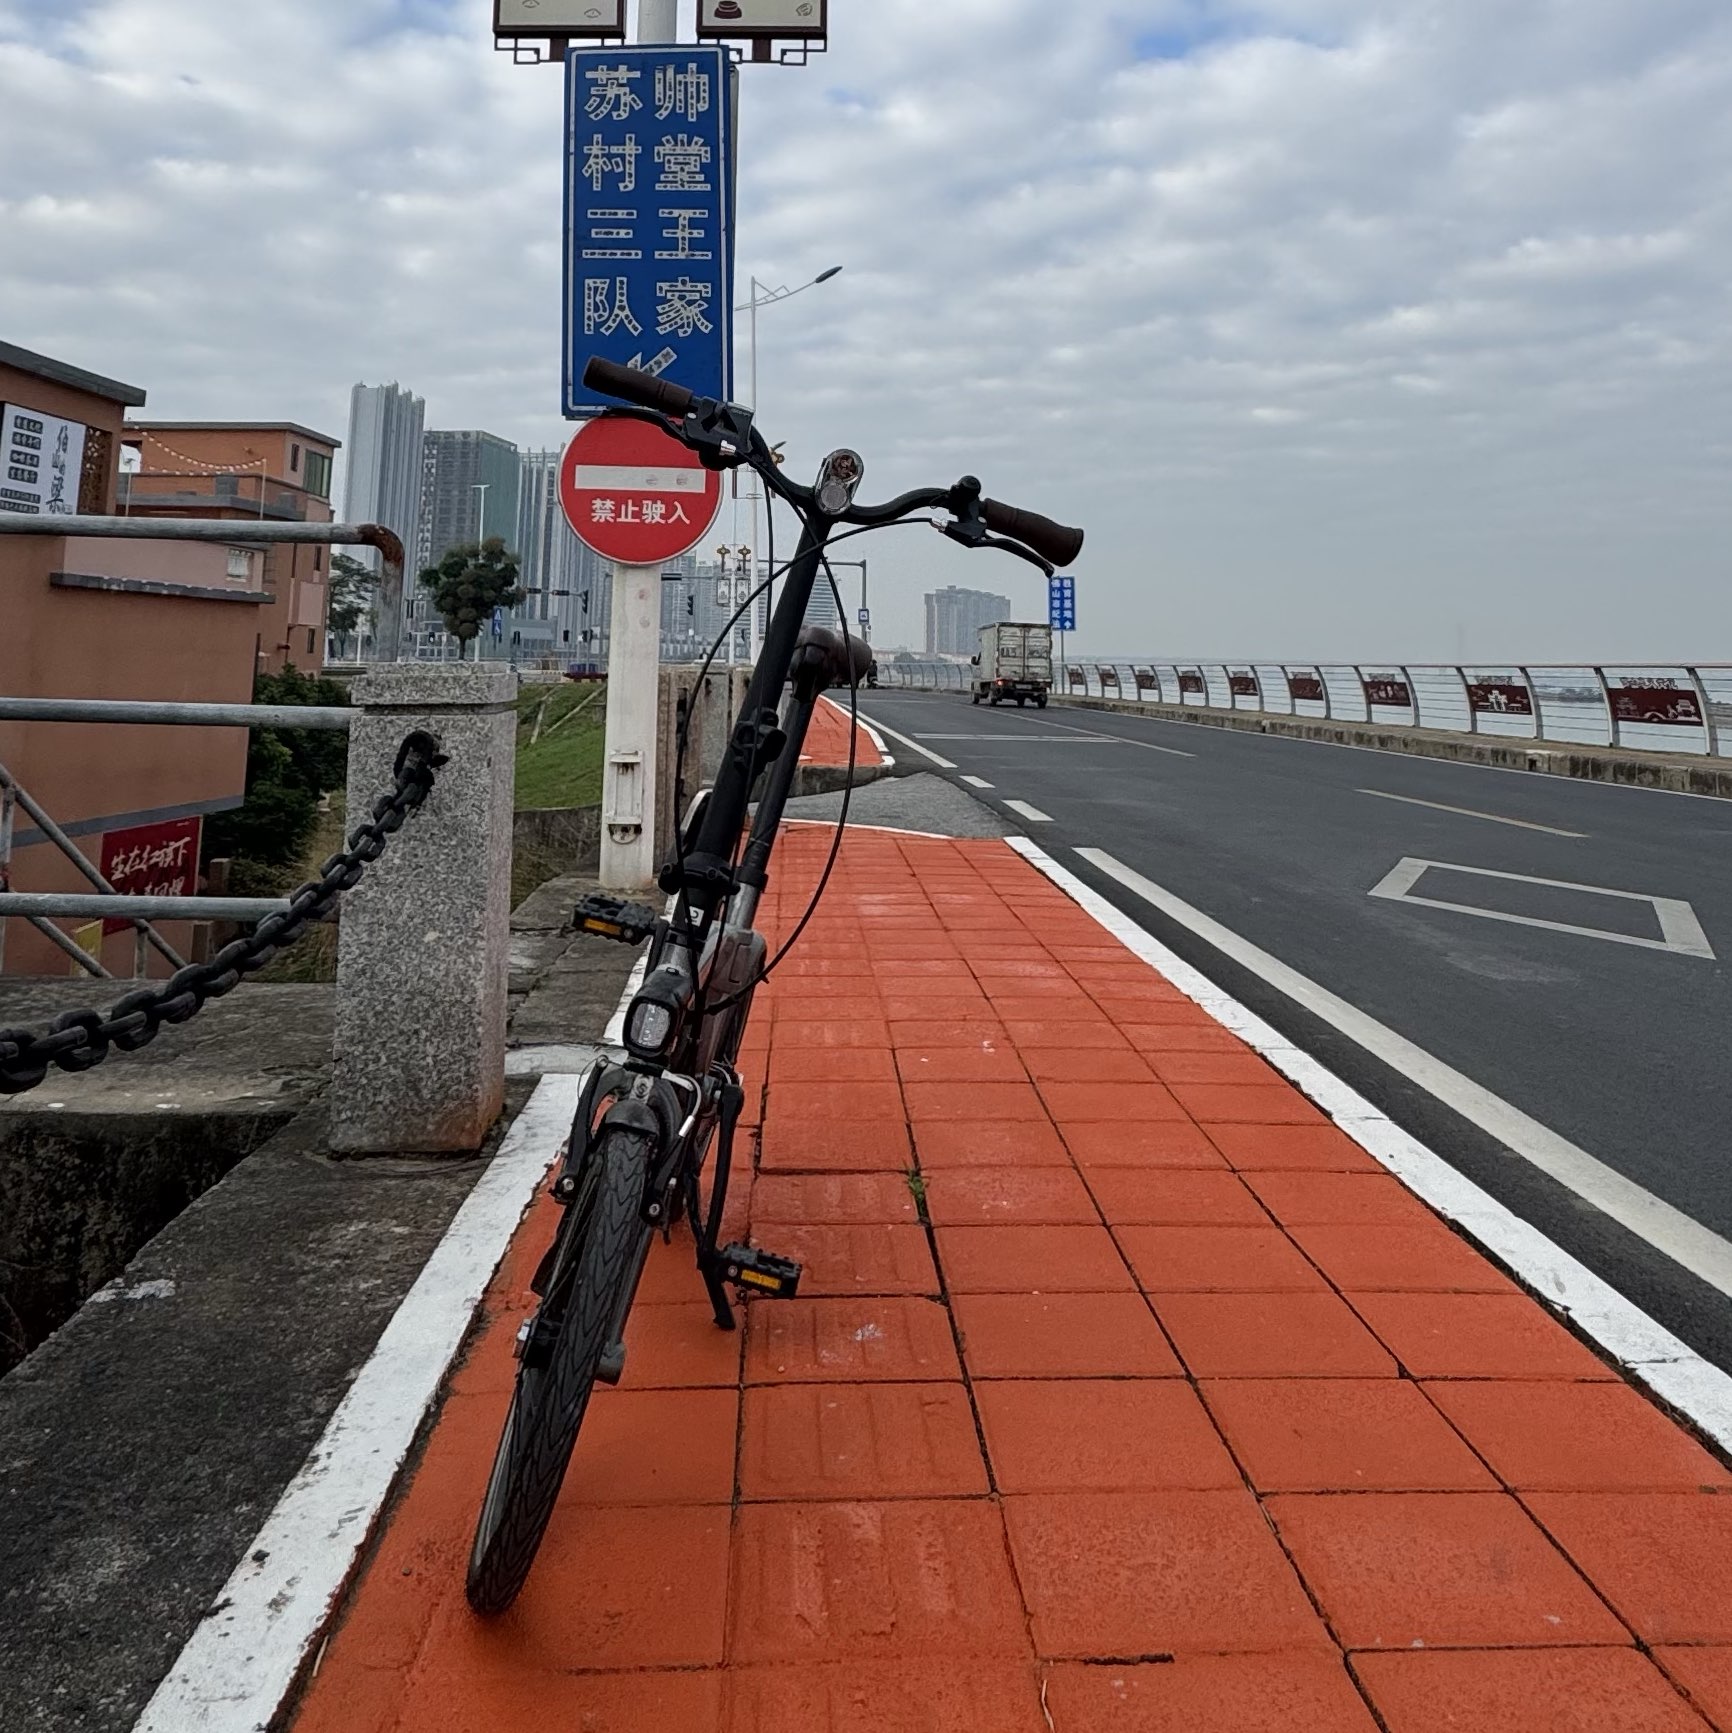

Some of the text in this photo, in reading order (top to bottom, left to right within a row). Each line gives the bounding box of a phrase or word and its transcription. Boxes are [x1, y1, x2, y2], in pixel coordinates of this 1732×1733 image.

[581, 64, 643, 336] 苏村三队
[654, 62, 713, 337] 帅堂王家
[591, 498, 690, 524] 禁止驶入
[111, 836, 191, 881] 生在红旗下
